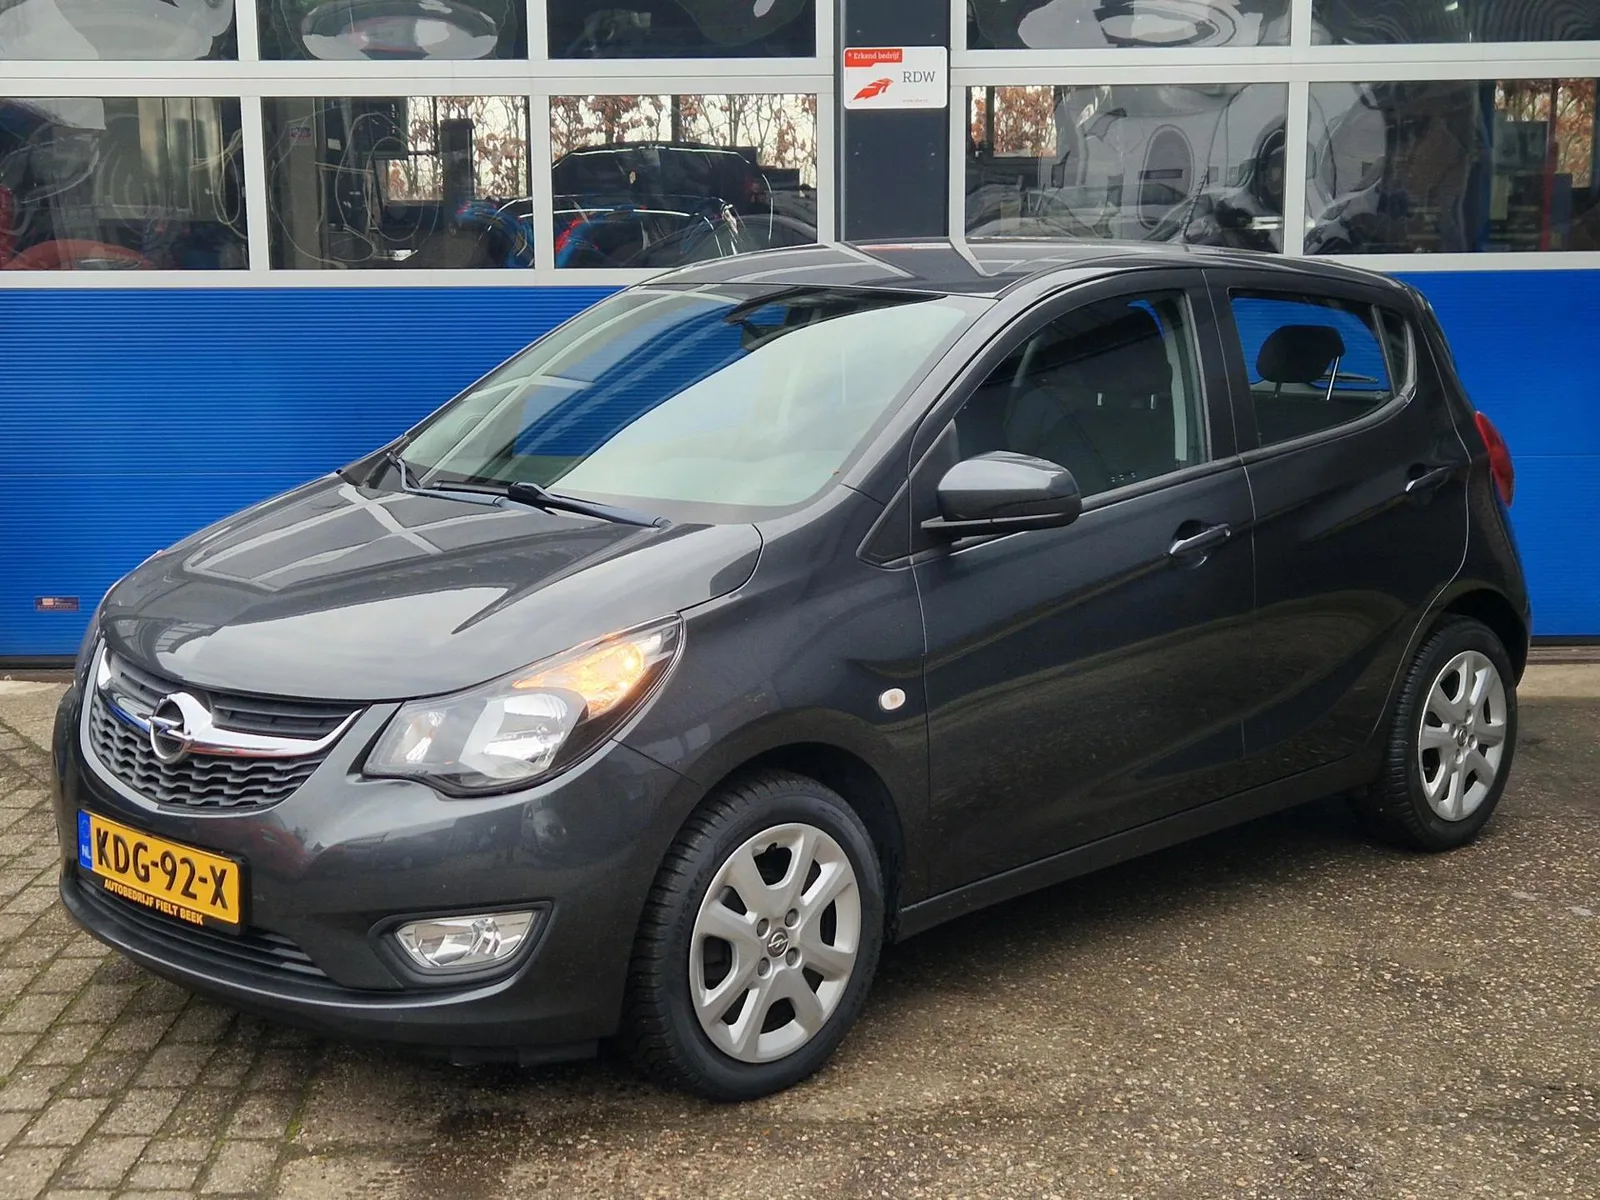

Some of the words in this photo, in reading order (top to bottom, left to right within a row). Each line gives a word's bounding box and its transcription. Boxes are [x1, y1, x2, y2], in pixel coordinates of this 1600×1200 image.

[853, 52, 877, 60] Erkend
[878, 51, 900, 61] bedrijf
[902, 70, 936, 83] RDW
[81, 844, 92, 860] NL
[95, 827, 228, 910] KDG-92-X
[104, 878, 154, 907] AUTOBEDRIJF
[180, 908, 204, 926] BEEK
